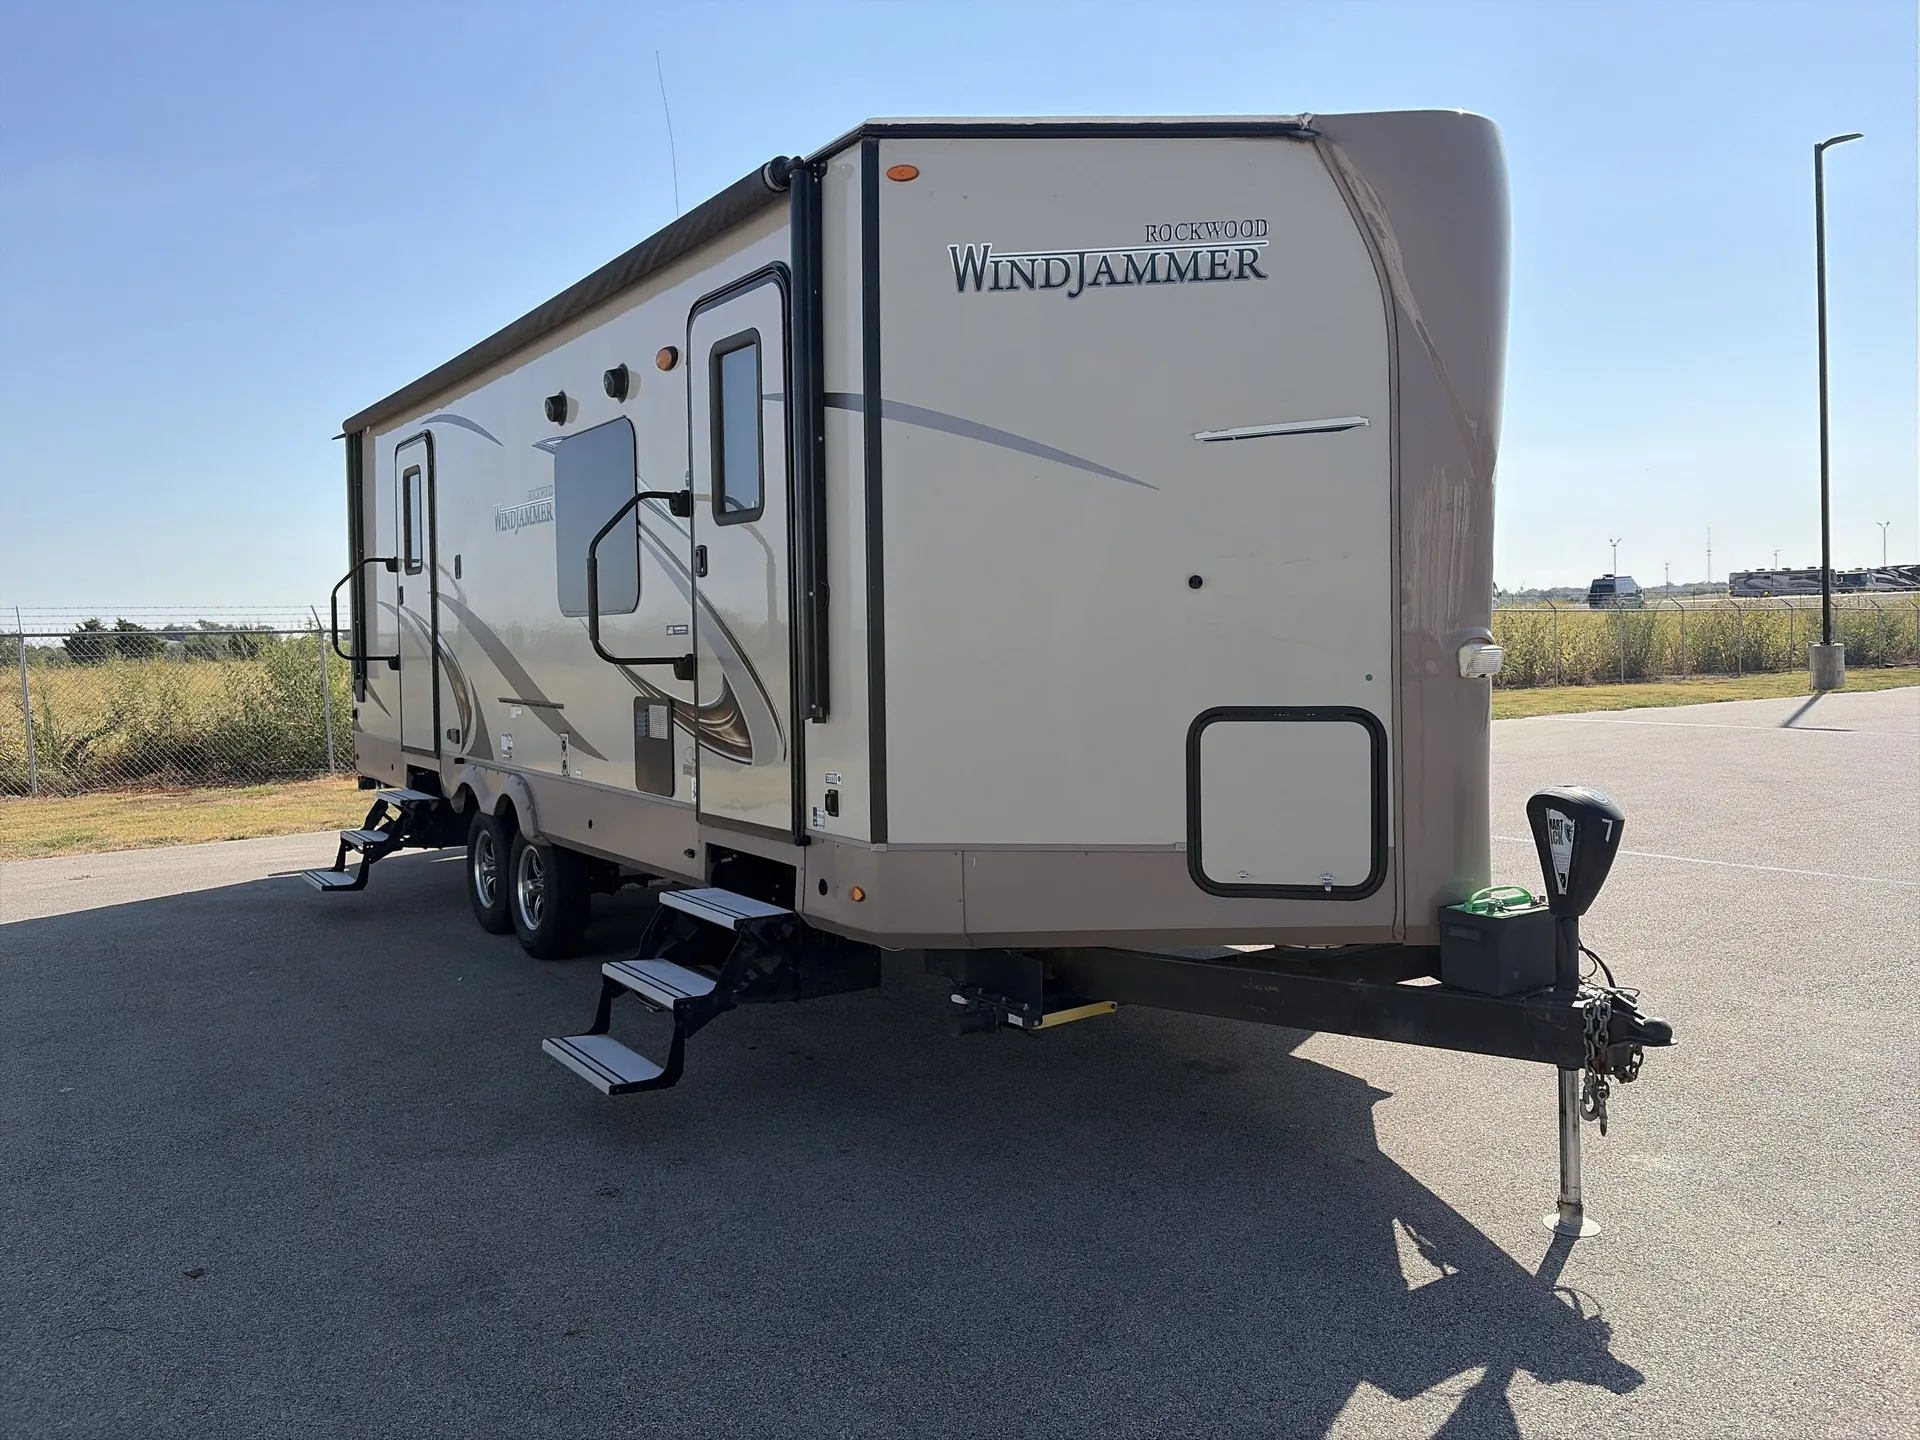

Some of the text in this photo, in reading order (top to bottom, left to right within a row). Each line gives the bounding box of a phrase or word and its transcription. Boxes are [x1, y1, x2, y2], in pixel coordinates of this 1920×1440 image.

[1145, 218, 1270, 243] ROCKWOOD
[948, 241, 1270, 300] WINDJAMMER
[493, 502, 554, 535] WINDJAMMER
